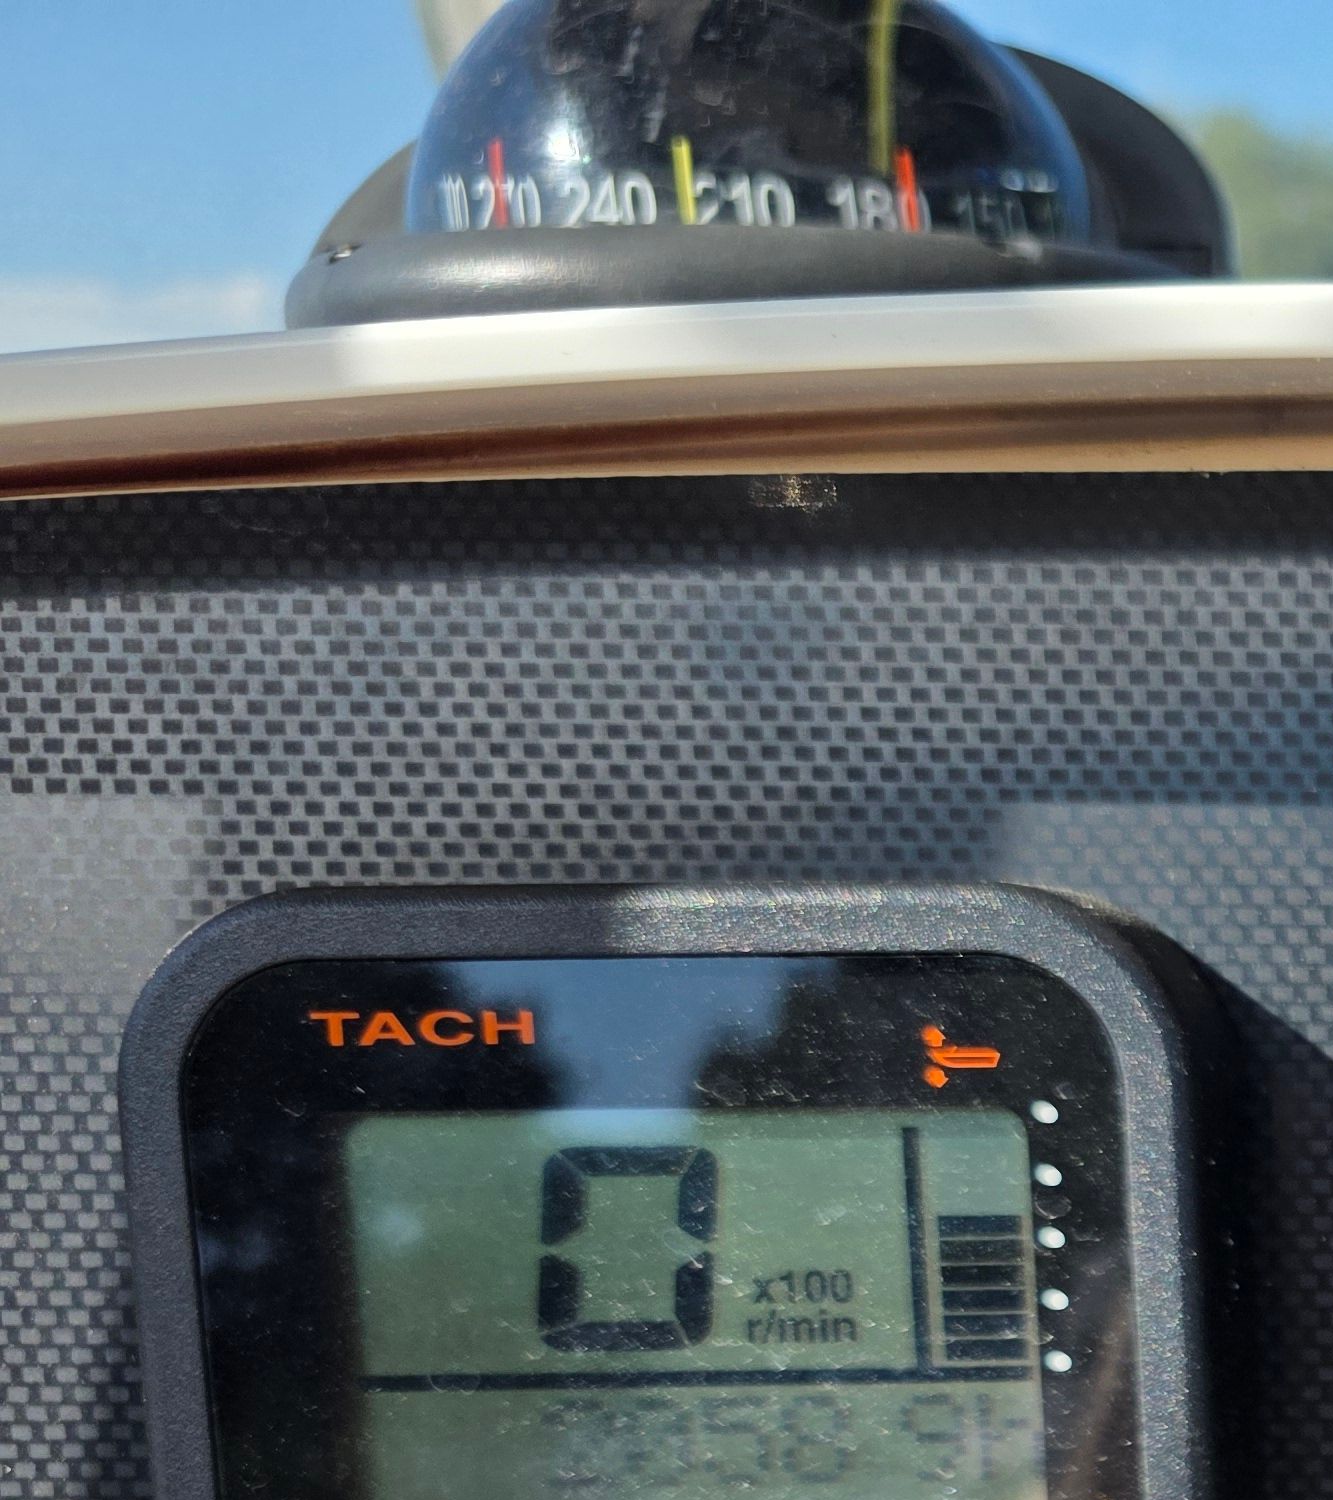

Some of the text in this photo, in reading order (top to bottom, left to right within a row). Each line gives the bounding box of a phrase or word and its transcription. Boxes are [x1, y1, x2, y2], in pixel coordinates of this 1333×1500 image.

[554, 172, 656, 229] 240
[824, 174, 931, 232] 180
[307, 1008, 536, 1047] TACH
[537, 1145, 719, 1351] 0
[752, 1269, 853, 1304] x100
[745, 1307, 856, 1344] r/min
